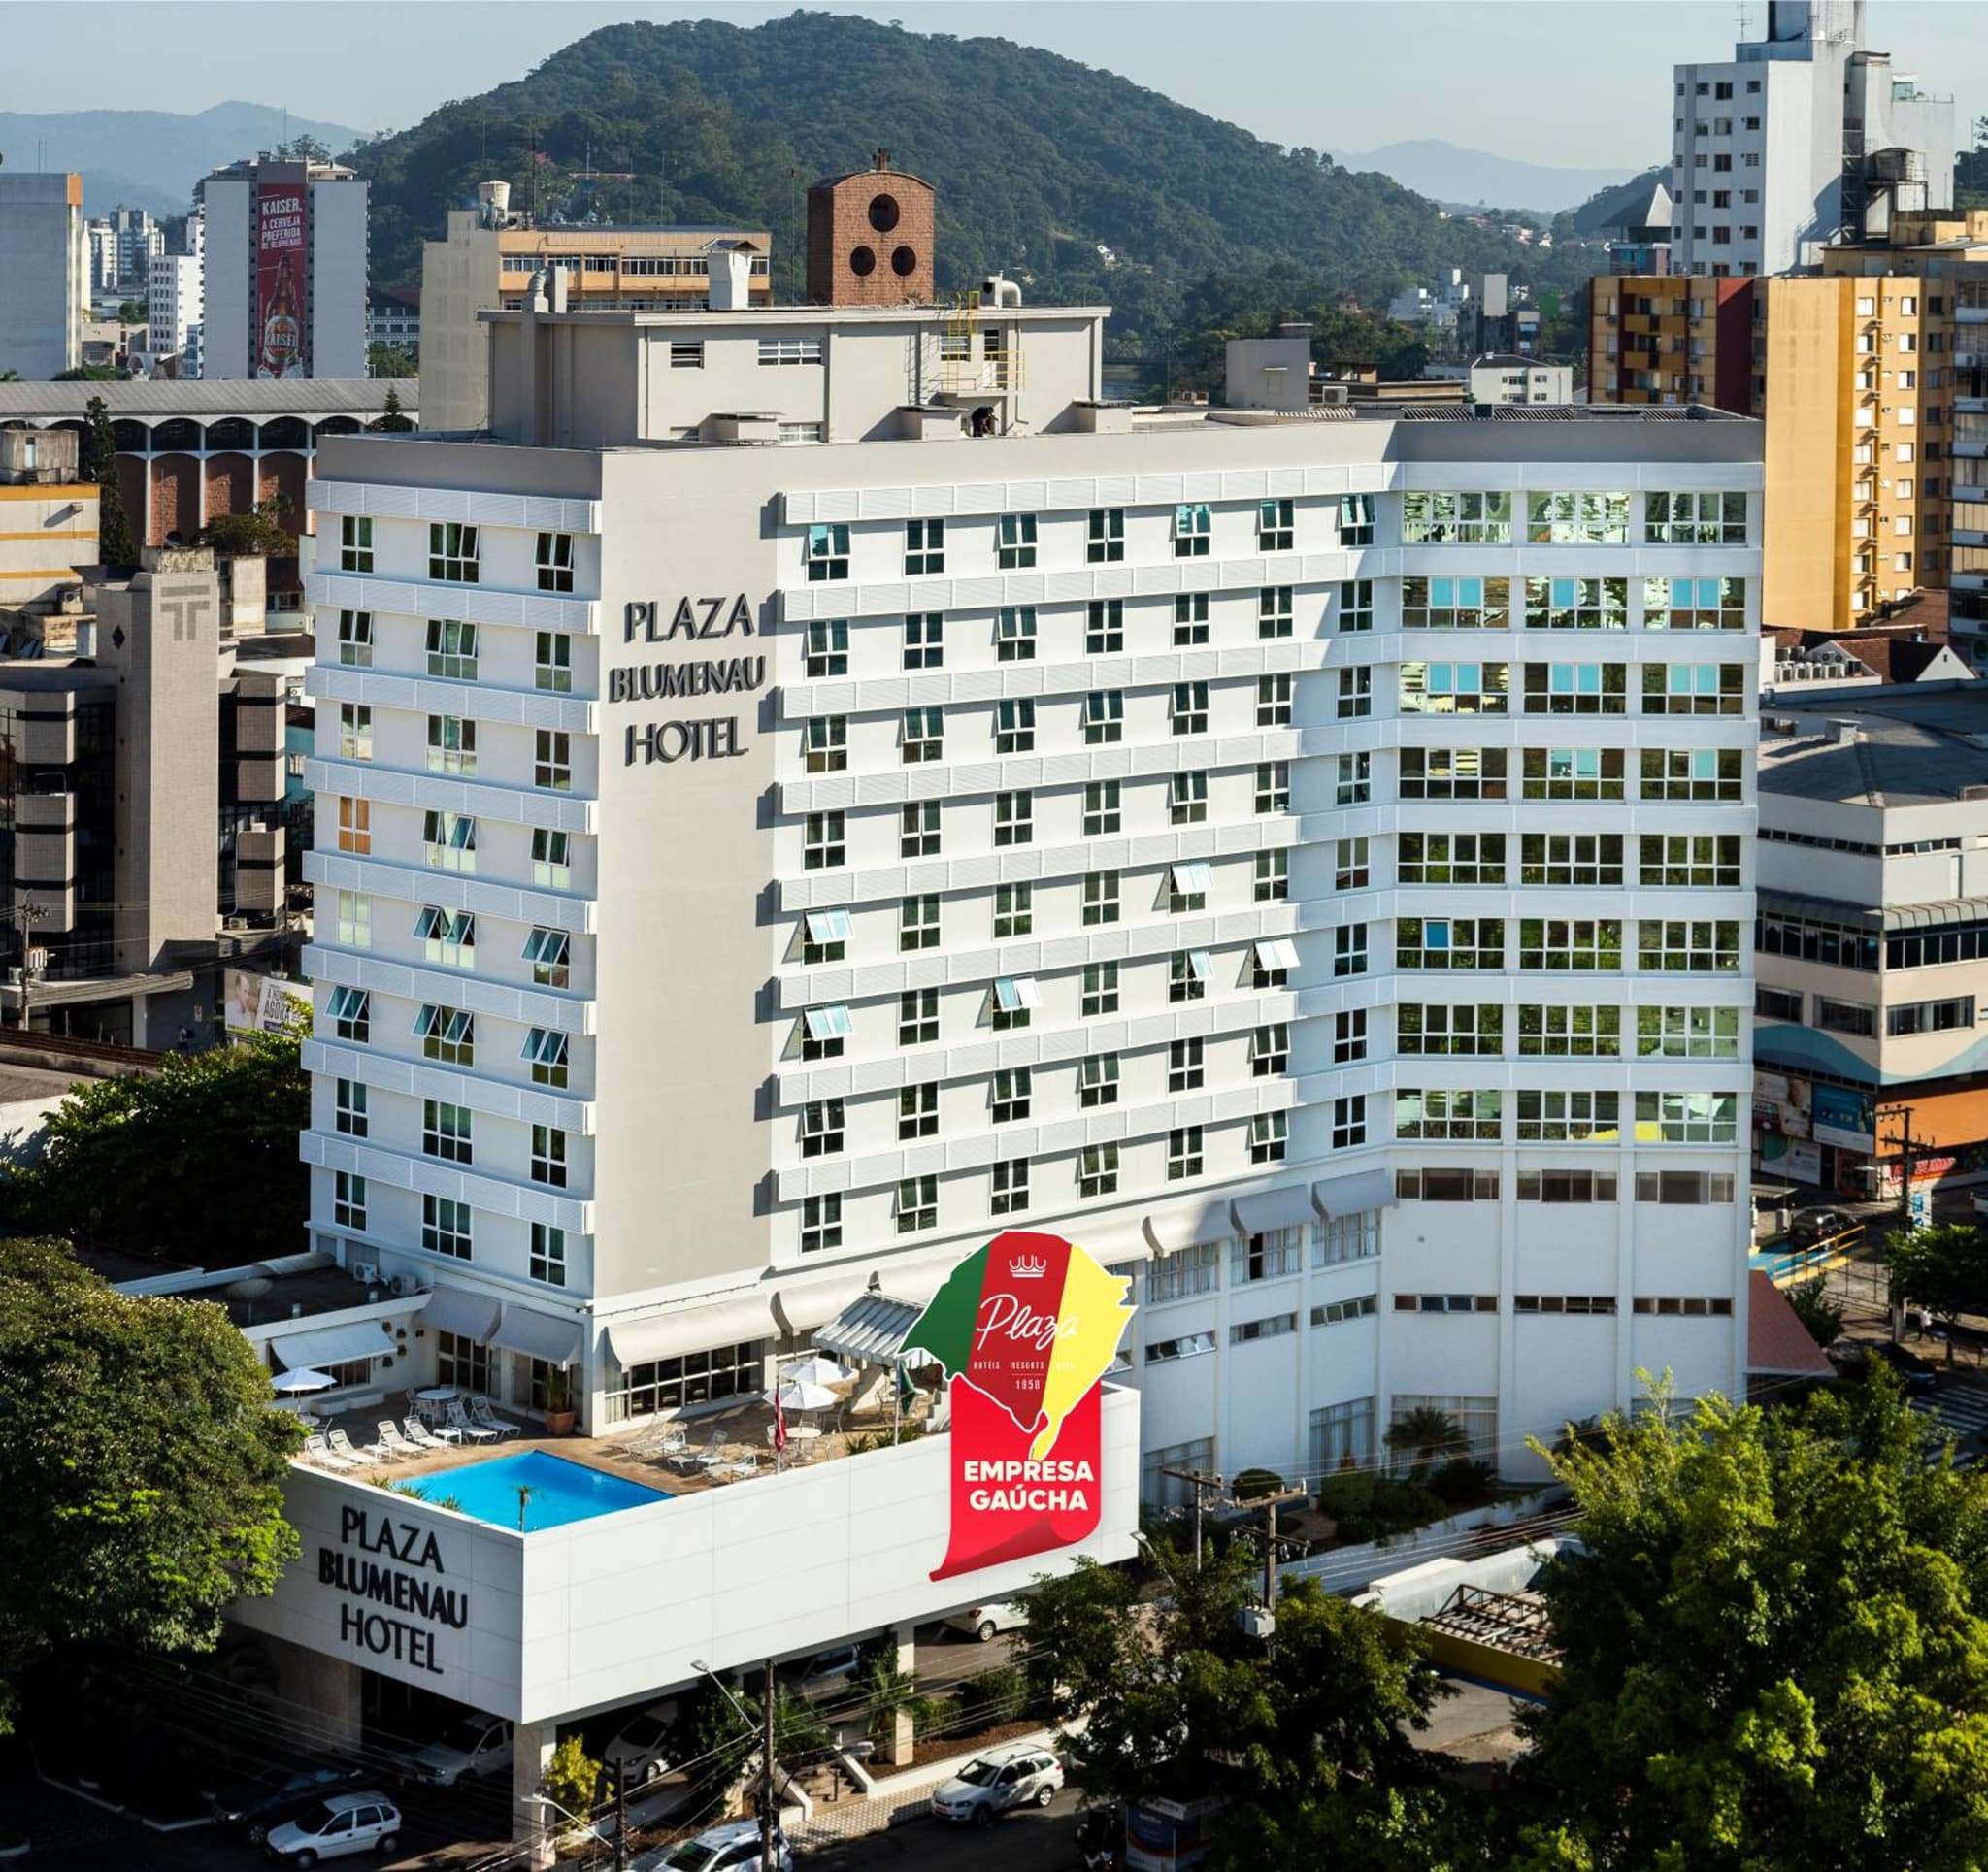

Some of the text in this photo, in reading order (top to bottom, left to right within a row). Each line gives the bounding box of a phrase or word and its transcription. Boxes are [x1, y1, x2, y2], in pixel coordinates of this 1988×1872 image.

[262, 215, 301, 230] A CERVEJA
[624, 593, 755, 643] PLAZA
[609, 655, 766, 703] BLUMENAU
[625, 716, 749, 766] HOTEL
[341, 1505, 444, 1573] PLAZA
[318, 1547, 468, 1629] BLUMENAU
[341, 1603, 444, 1675] HOTEL
